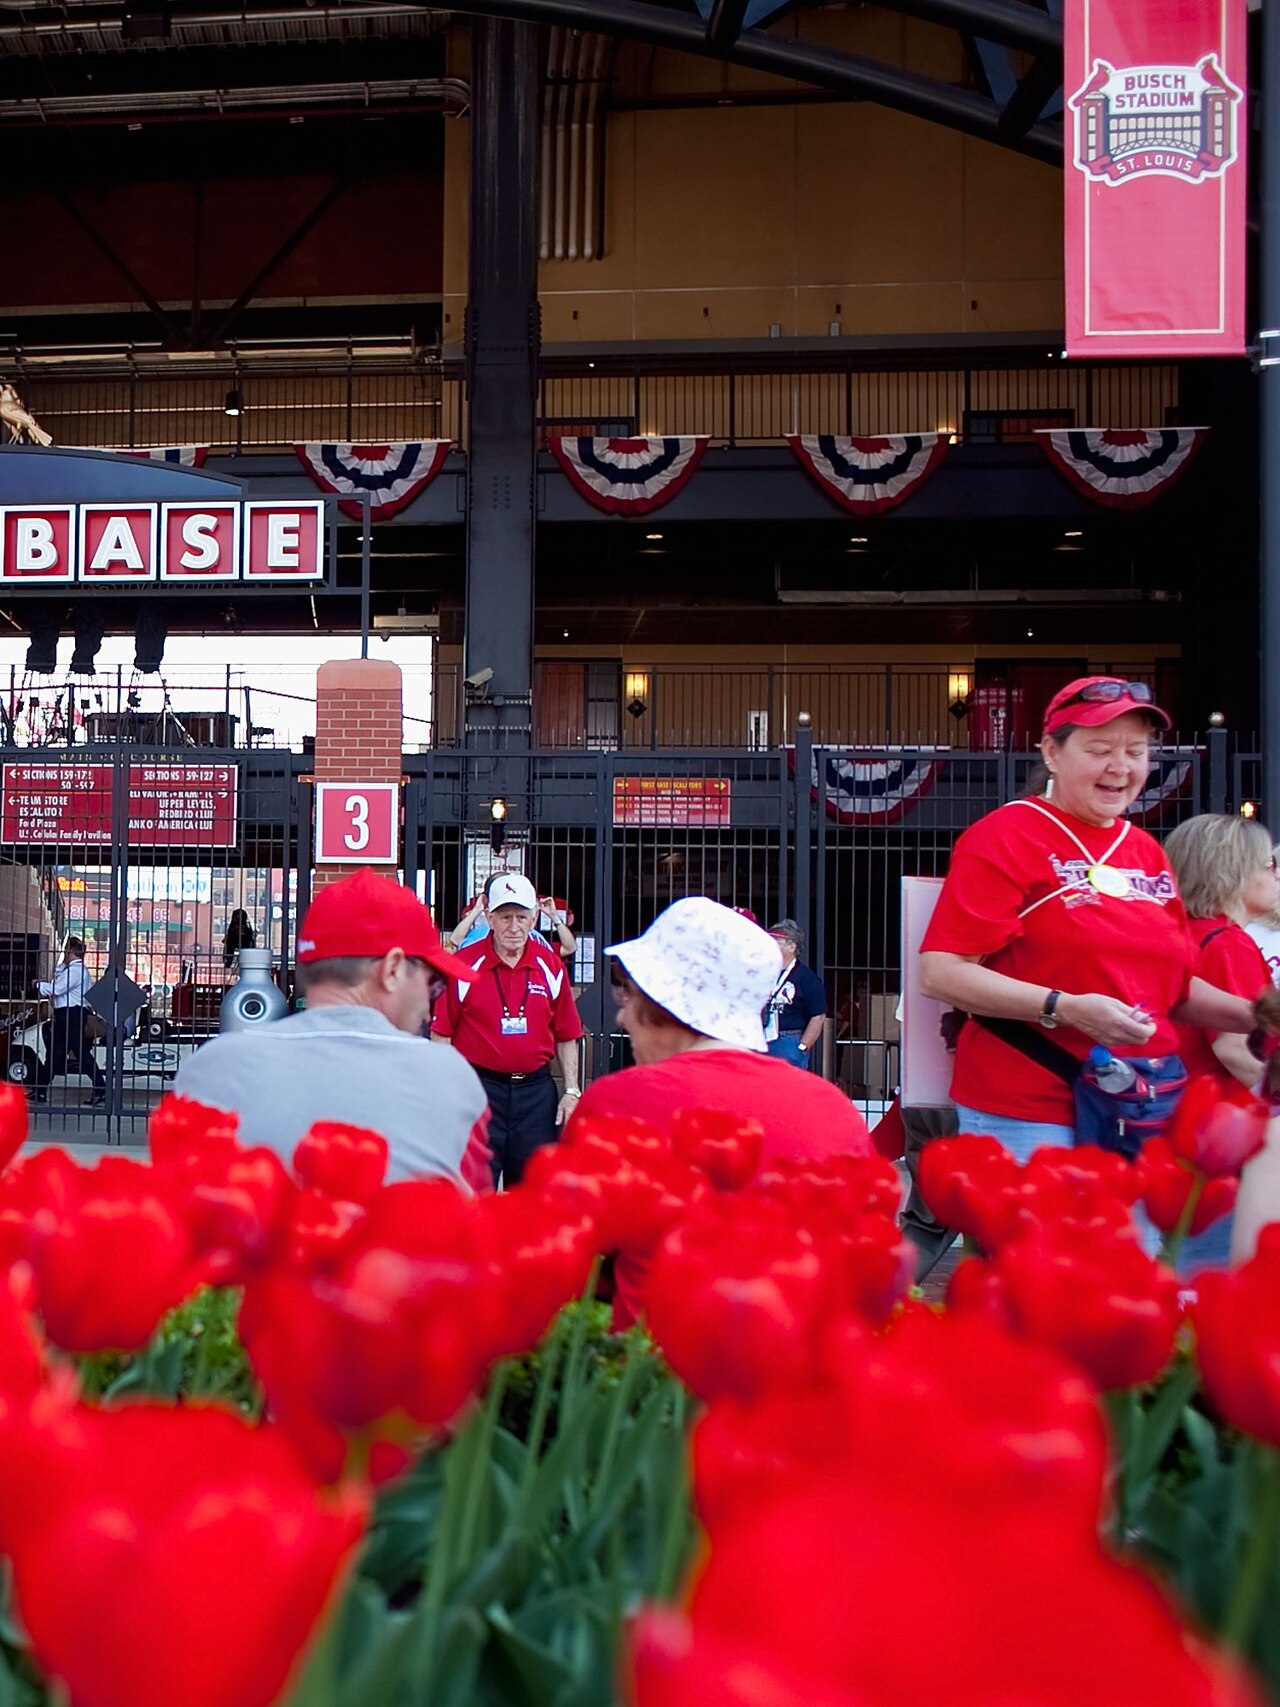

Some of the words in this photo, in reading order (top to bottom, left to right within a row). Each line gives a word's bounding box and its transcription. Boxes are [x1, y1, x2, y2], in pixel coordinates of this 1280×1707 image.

[1124, 74, 1186, 91] BUSCH
[1115, 91, 1195, 108] STADIUM
[1116, 158, 1140, 174] ST.
[1145, 154, 1193, 171] LOUIS
[16, 513, 301, 571] BASE
[344, 794, 370, 851] 3
